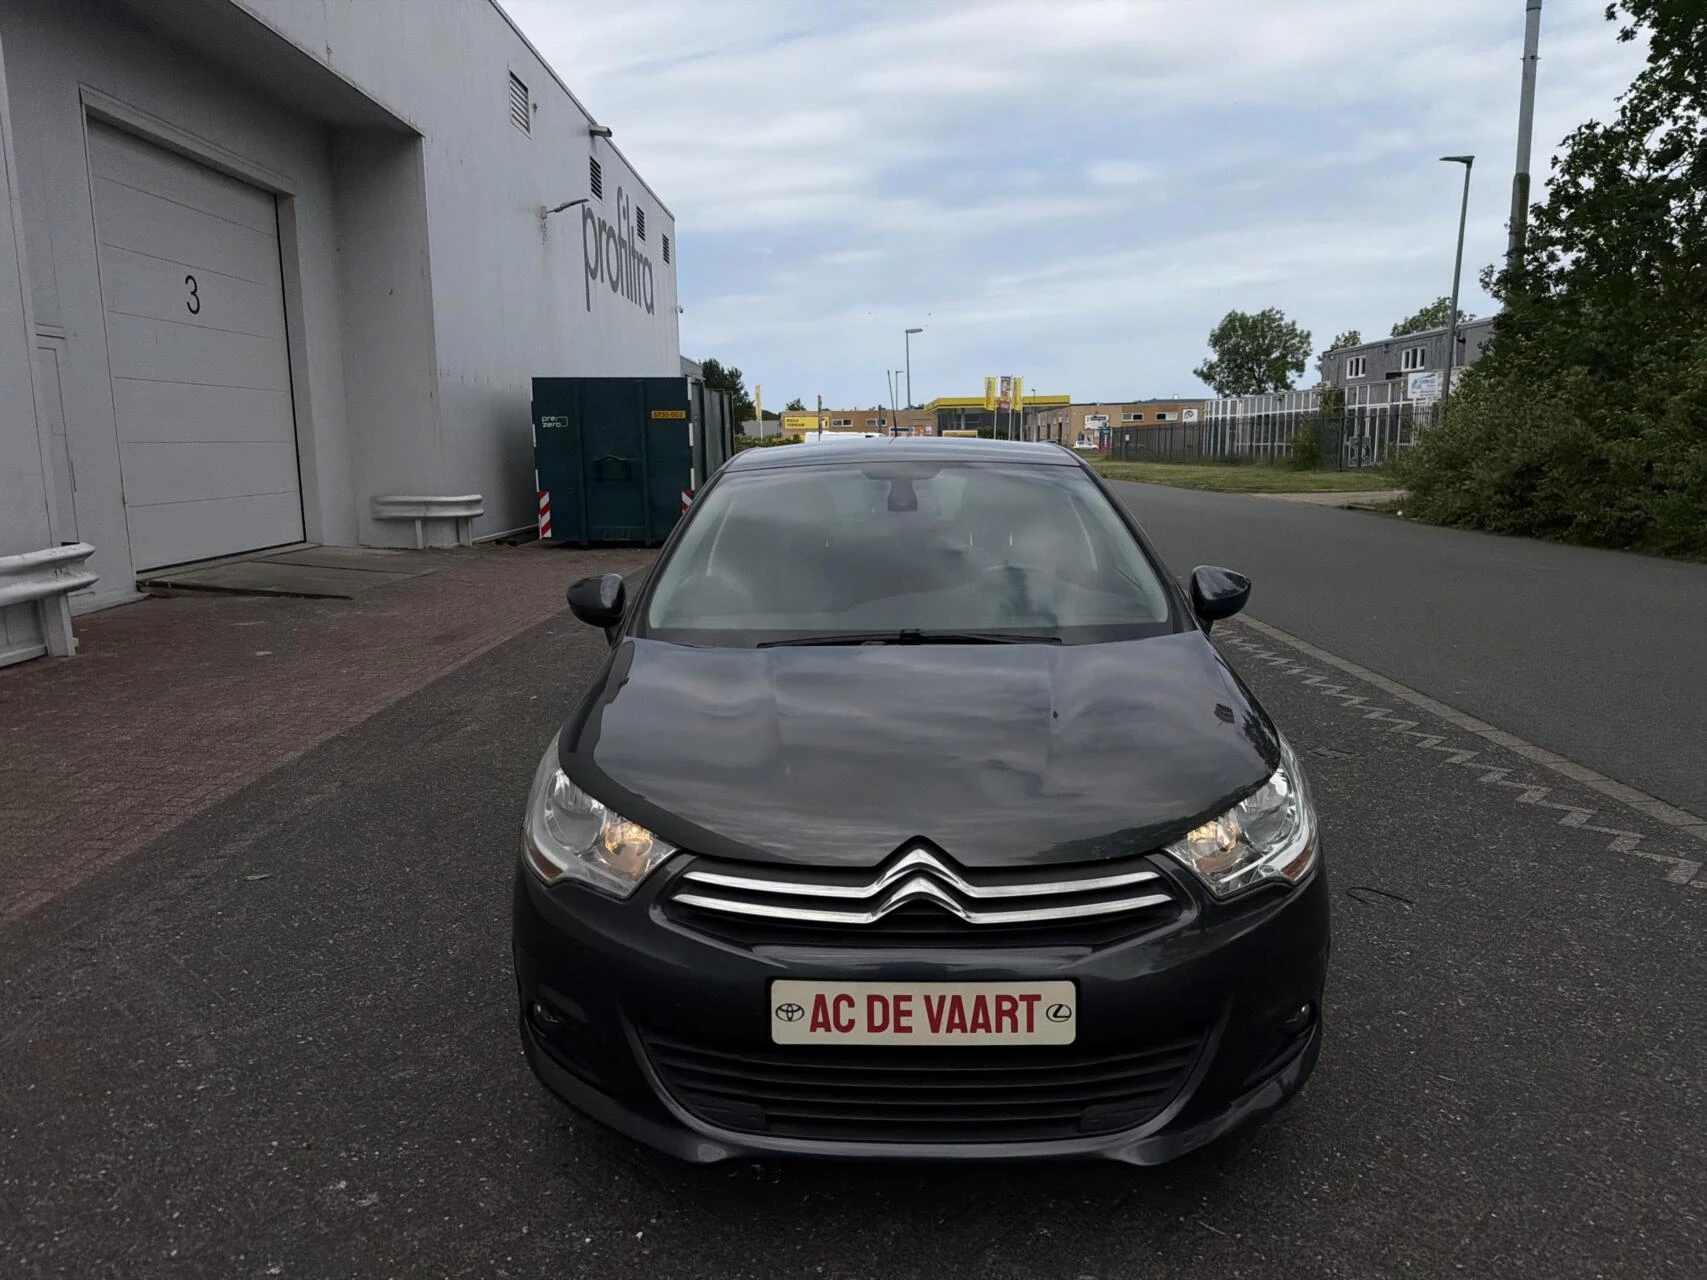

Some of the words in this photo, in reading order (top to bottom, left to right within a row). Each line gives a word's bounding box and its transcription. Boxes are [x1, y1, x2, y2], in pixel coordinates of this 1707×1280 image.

[582, 186, 655, 315] profiltra
[185, 275, 200, 315] 3
[809, 994, 856, 1034] AC
[867, 995, 913, 1034] DE
[924, 995, 1042, 1034] VAART
